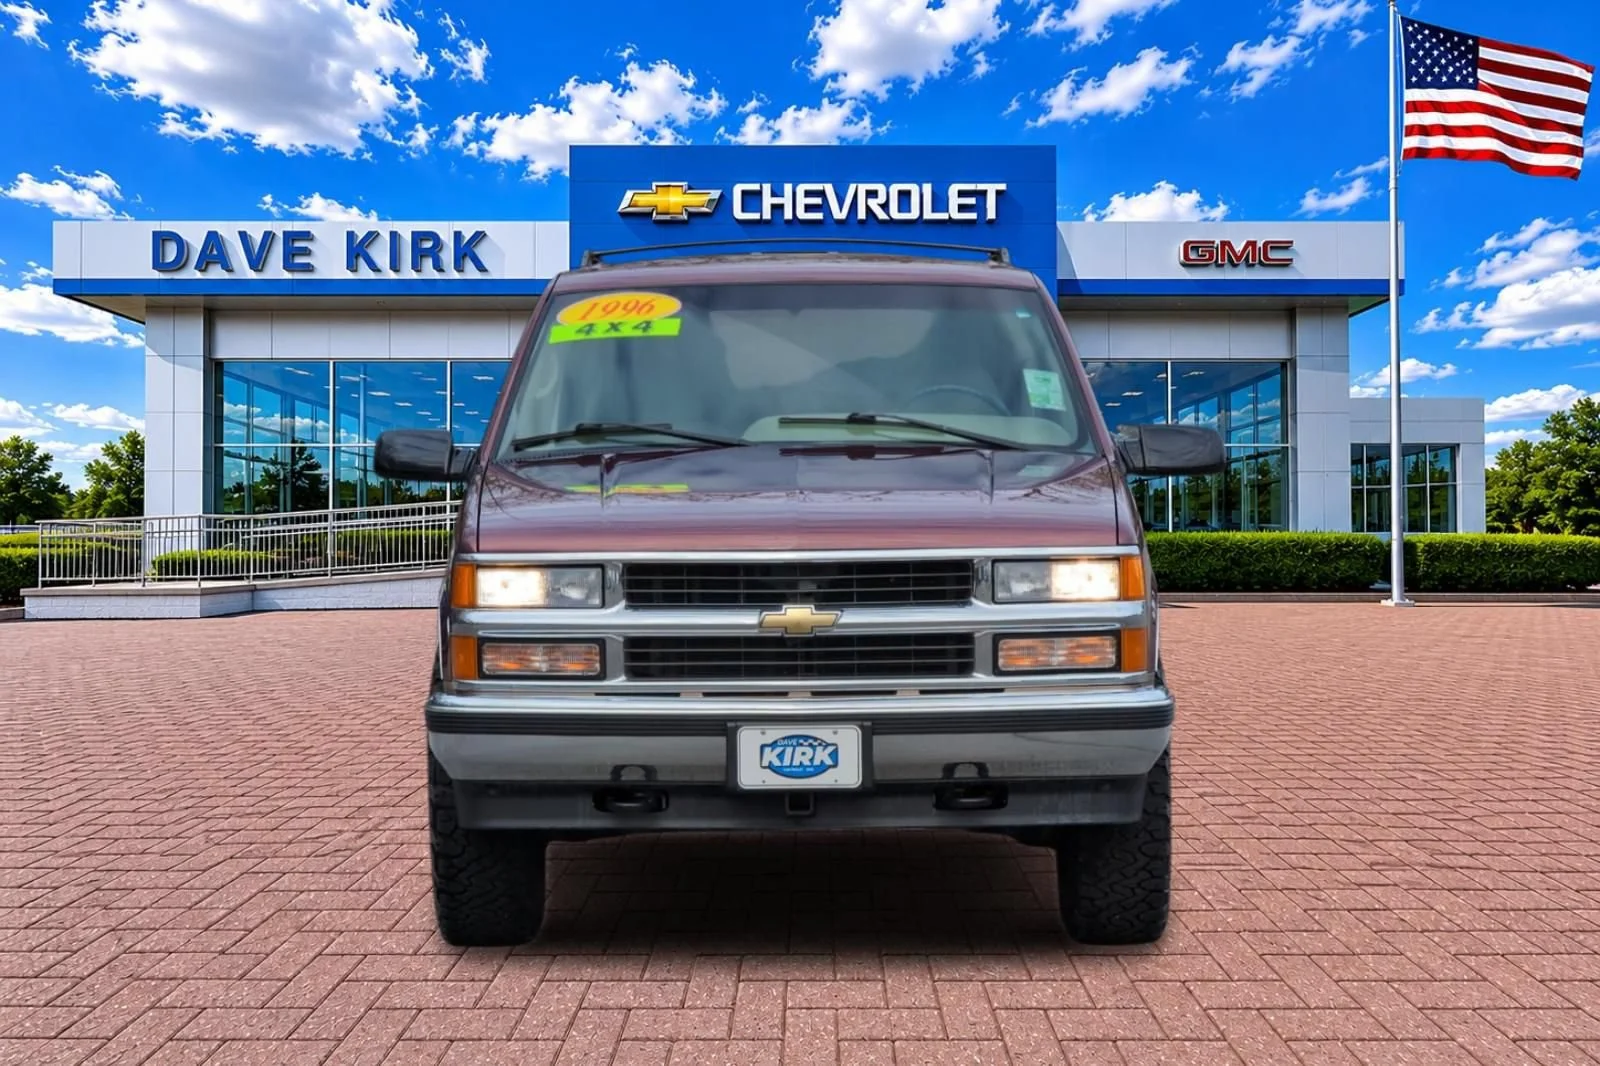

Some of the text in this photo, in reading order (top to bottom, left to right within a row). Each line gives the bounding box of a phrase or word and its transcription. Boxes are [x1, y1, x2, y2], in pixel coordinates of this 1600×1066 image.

[732, 182, 1007, 222] CHEVROLET
[151, 229, 489, 273] DAVE KIRK
[1180, 239, 1295, 267] GMC
[579, 299, 657, 320] 1996
[777, 738, 797, 746] DAVE
[762, 746, 836, 766] KIRK
